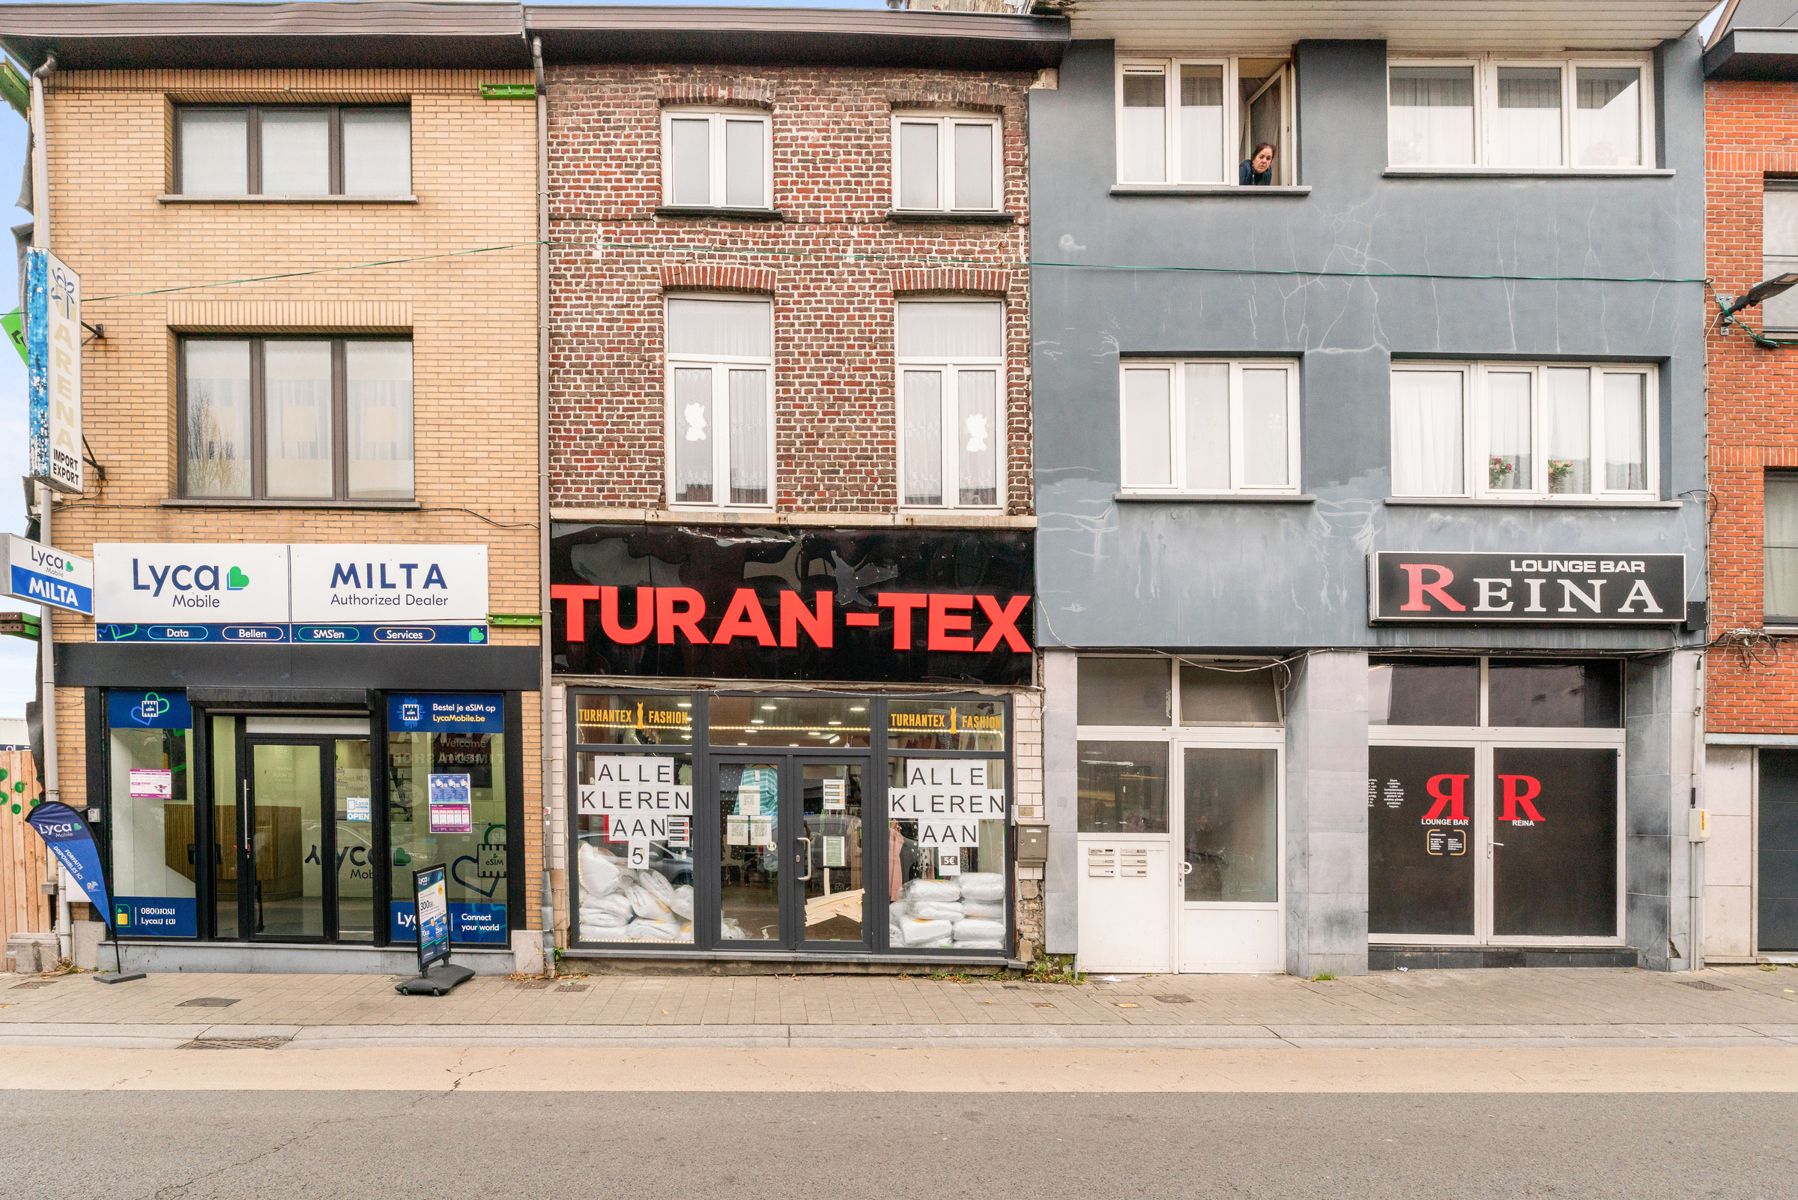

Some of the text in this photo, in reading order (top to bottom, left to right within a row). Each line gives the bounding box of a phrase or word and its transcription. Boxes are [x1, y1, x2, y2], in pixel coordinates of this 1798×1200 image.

[54, 323, 76, 454] ARENA
[53, 448, 79, 471] IMPORT
[52, 463, 80, 486] EXPORT
[31, 545, 64, 570] Lyca
[1510, 559, 1646, 574] LOUNGE BAR
[132, 558, 220, 598] Lyca
[330, 562, 448, 590] MILTA
[28, 576, 79, 607] MILTA
[1400, 563, 1662, 613] REINA
[172, 594, 221, 609] Mobile
[330, 593, 449, 607] Authorized Dealer
[550, 584, 1033, 653] TURAN-TEX
[166, 628, 190, 639] Data
[238, 628, 268, 639] Bellen
[386, 629, 424, 641] Services
[456, 704, 464, 713] je
[579, 709, 688, 724] TURHANTEX FASHION
[432, 714, 486, 722] LycaMobile.be
[891, 714, 1002, 728] TURHANTEX FASHION
[599, 764, 670, 783] ALLE
[911, 768, 985, 785] ALLE
[582, 791, 690, 809] KLEREN
[893, 795, 1005, 813] KLEREN
[1497, 774, 1547, 821] R
[38, 823, 73, 836] Lyca
[613, 819, 667, 837] AAN
[921, 825, 977, 843] AAN
[632, 847, 644, 865] 5
[461, 913, 491, 921] Connect
[461, 924, 477, 932] your
